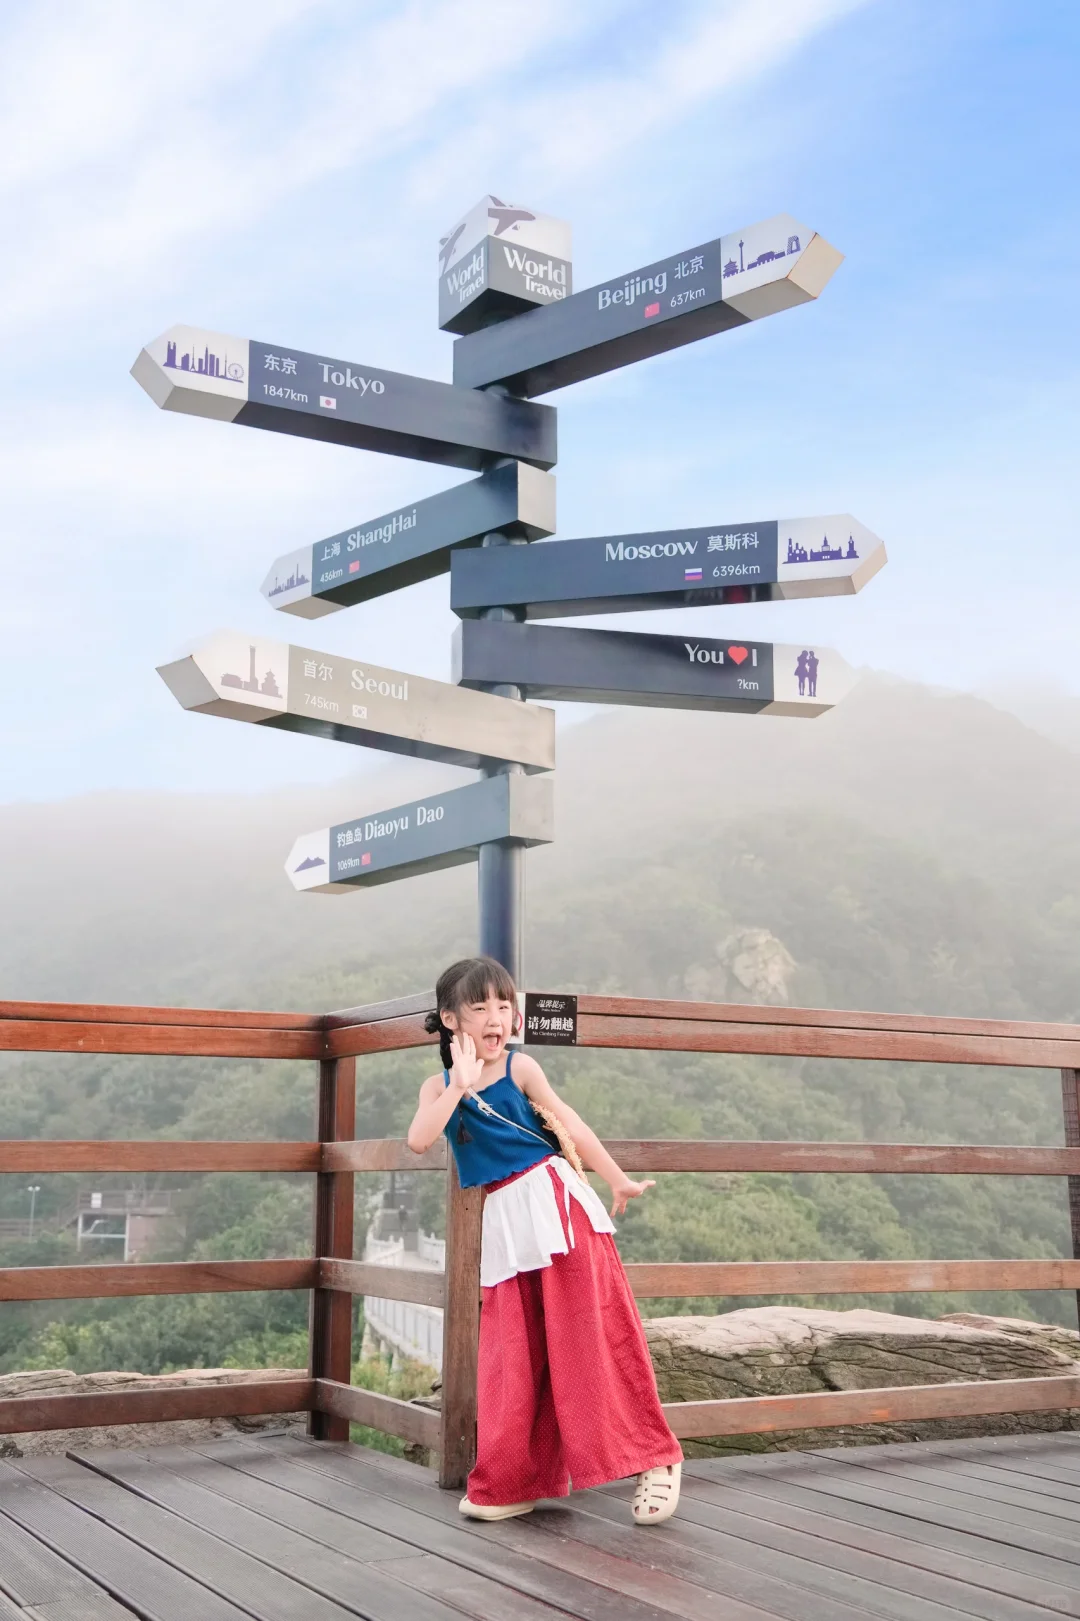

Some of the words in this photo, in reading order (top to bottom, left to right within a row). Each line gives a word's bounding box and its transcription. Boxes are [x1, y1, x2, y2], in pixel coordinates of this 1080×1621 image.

[446, 246, 485, 296] World
[503, 245, 567, 286] World
[459, 269, 485, 303] Travel
[522, 272, 567, 301] Travel
[598, 272, 667, 311] Beijing
[674, 255, 705, 280] 北京
[670, 287, 706, 308] 637km
[263, 353, 298, 376] 东京
[318, 362, 386, 397] Tokyo
[263, 384, 309, 404] 1847km
[320, 541, 341, 561] 上海
[346, 508, 417, 552] ShangHai
[605, 540, 699, 562] Moscow
[706, 531, 760, 553] 莫斯科
[319, 568, 344, 584] 436km
[712, 563, 761, 578] 6396km
[683, 643, 725, 665] You
[751, 648, 758, 667] I
[302, 658, 334, 682] 首尔
[350, 668, 409, 701] Seoul
[736, 678, 760, 691] ?km
[303, 693, 340, 713] 745km
[336, 826, 363, 849] 钓鱼岛
[364, 815, 410, 841] Diaoyu
[416, 805, 445, 827] Dao
[337, 857, 361, 872] 1069km
[528, 1016, 573, 1031] 请勿翻越
